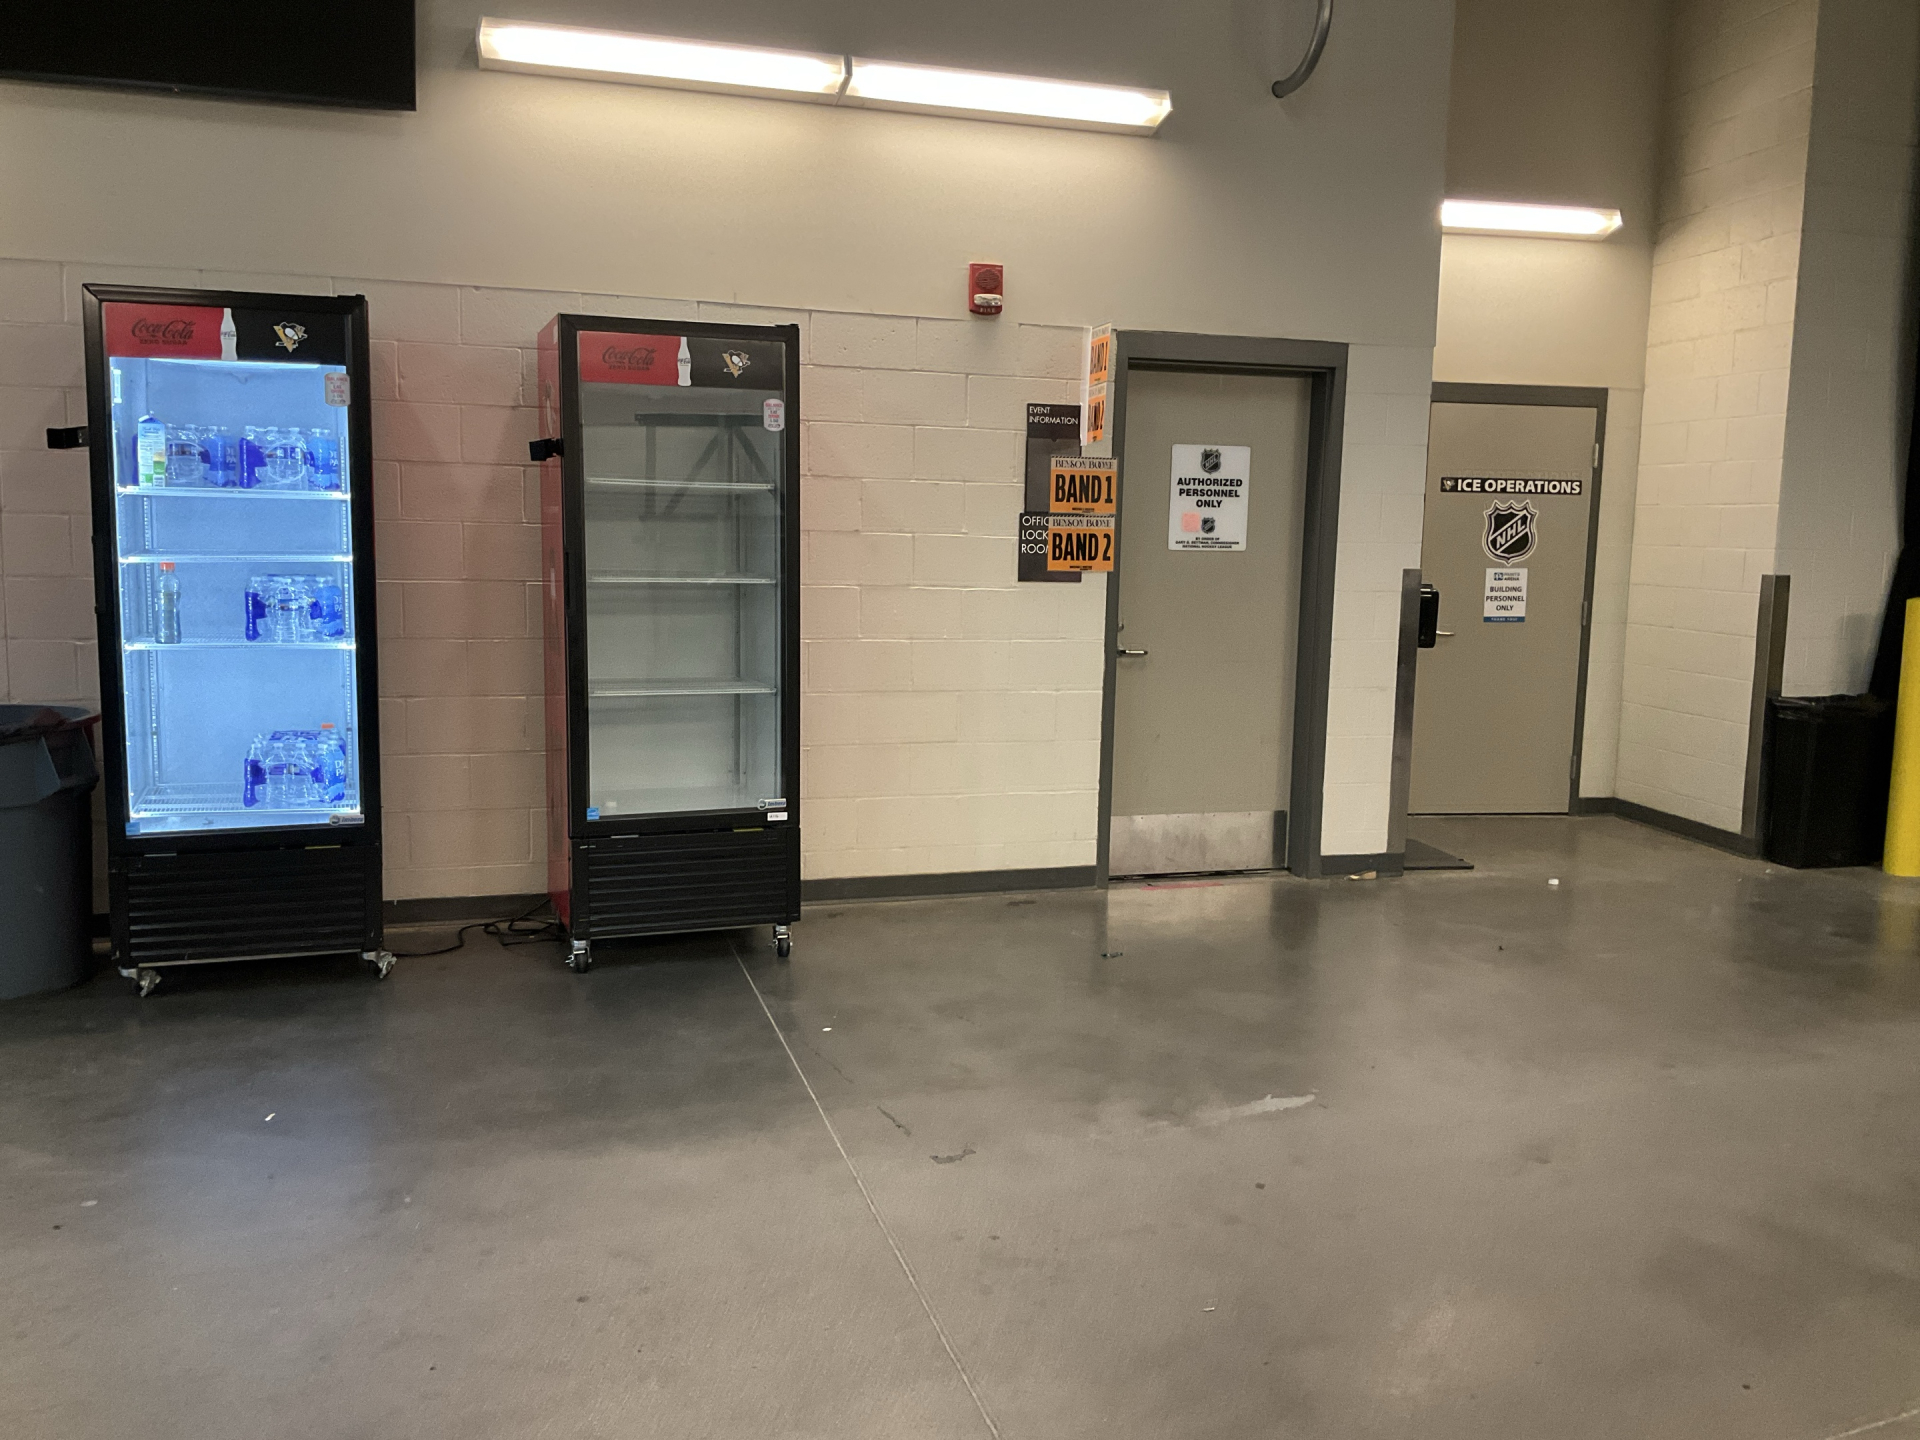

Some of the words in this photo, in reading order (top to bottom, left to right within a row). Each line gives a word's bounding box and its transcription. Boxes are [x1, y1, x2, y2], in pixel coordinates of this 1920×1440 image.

[1029, 406, 1051, 414] EVENT
[1029, 416, 1079, 425] INFORMATION
[1177, 477, 1243, 487] AUTHORIZED
[1457, 479, 1481, 491] ICE
[1484, 480, 1580, 494] OPERATIONS
[1055, 474, 1102, 504] BAND
[1104, 476, 1113, 504] 1
[1179, 488, 1240, 497] PERSONNEL
[1196, 499, 1223, 508] ONLY
[1495, 518, 1527, 549] NHL
[1052, 533, 1099, 562] BAND
[1103, 534, 1111, 562] 2
